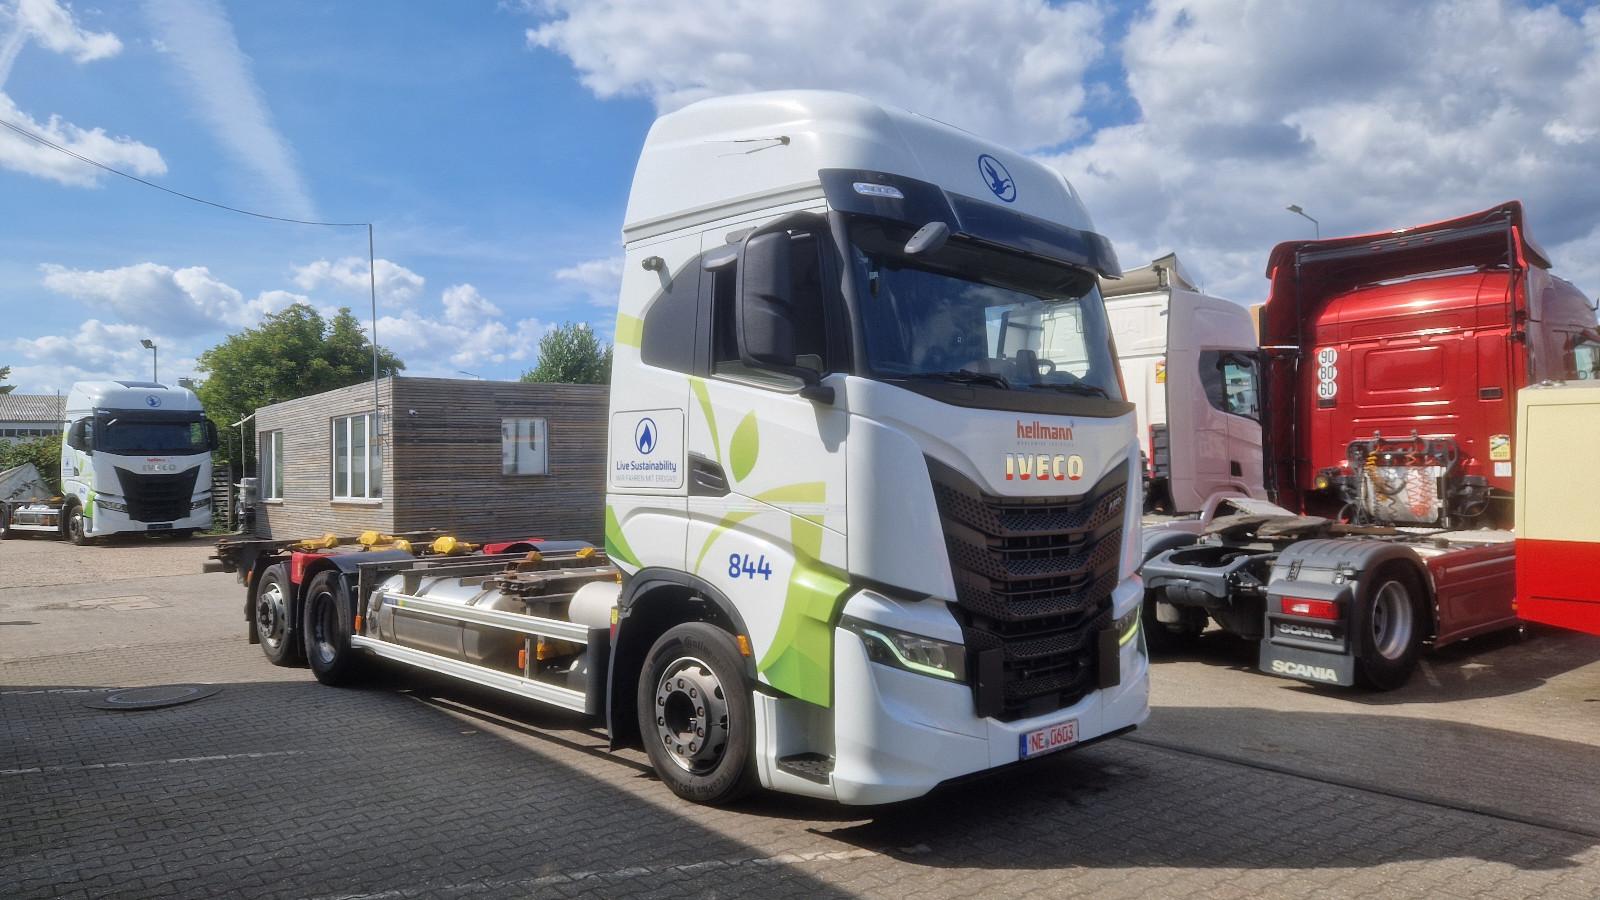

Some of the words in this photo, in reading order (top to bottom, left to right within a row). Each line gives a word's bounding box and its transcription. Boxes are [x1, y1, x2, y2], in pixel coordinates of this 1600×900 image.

[1321, 350, 1335, 363] 90
[1321, 366, 1334, 379] 80
[1321, 382, 1334, 395] 60
[1016, 419, 1073, 440] hellmann
[616, 460, 630, 471] Live
[630, 460, 677, 472] Sustainability
[1005, 453, 1084, 481] IVECO
[728, 553, 772, 581] 844
[1279, 623, 1334, 640] SCANIA
[1271, 659, 1338, 682] SCANIA
[1031, 732, 1045, 752] NE
[1050, 724, 1073, 746] 0603
